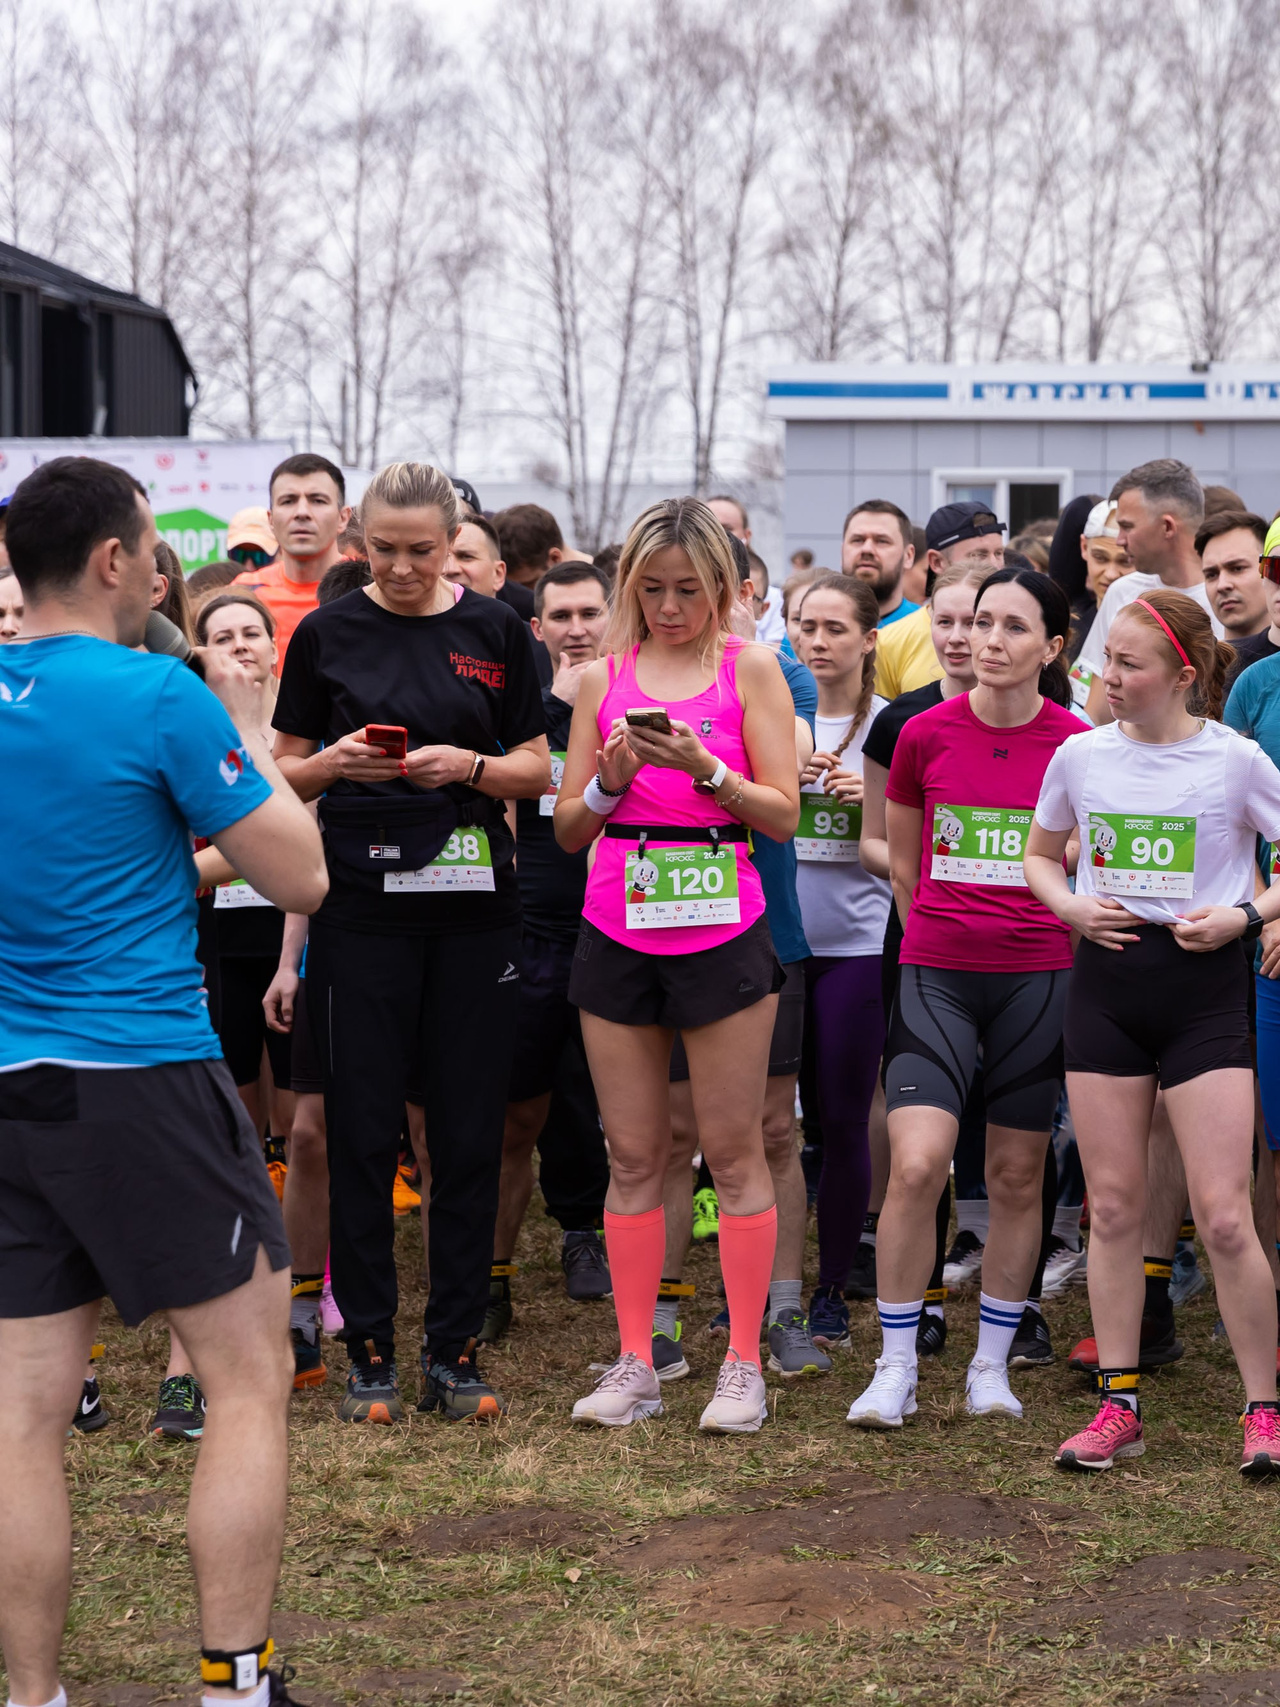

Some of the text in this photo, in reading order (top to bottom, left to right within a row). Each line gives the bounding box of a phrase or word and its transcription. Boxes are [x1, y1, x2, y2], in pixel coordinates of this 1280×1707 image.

[449, 652, 505, 670] Настоящи
[455, 665, 505, 689] ЛИДЕ
[814, 811, 850, 836] 93
[1008, 815, 1030, 824] 2025
[1162, 822, 1185, 831] 2025
[434, 834, 480, 860] 38
[975, 828, 1022, 857] 118
[1130, 836, 1175, 866] 90
[668, 866, 724, 896] 120
